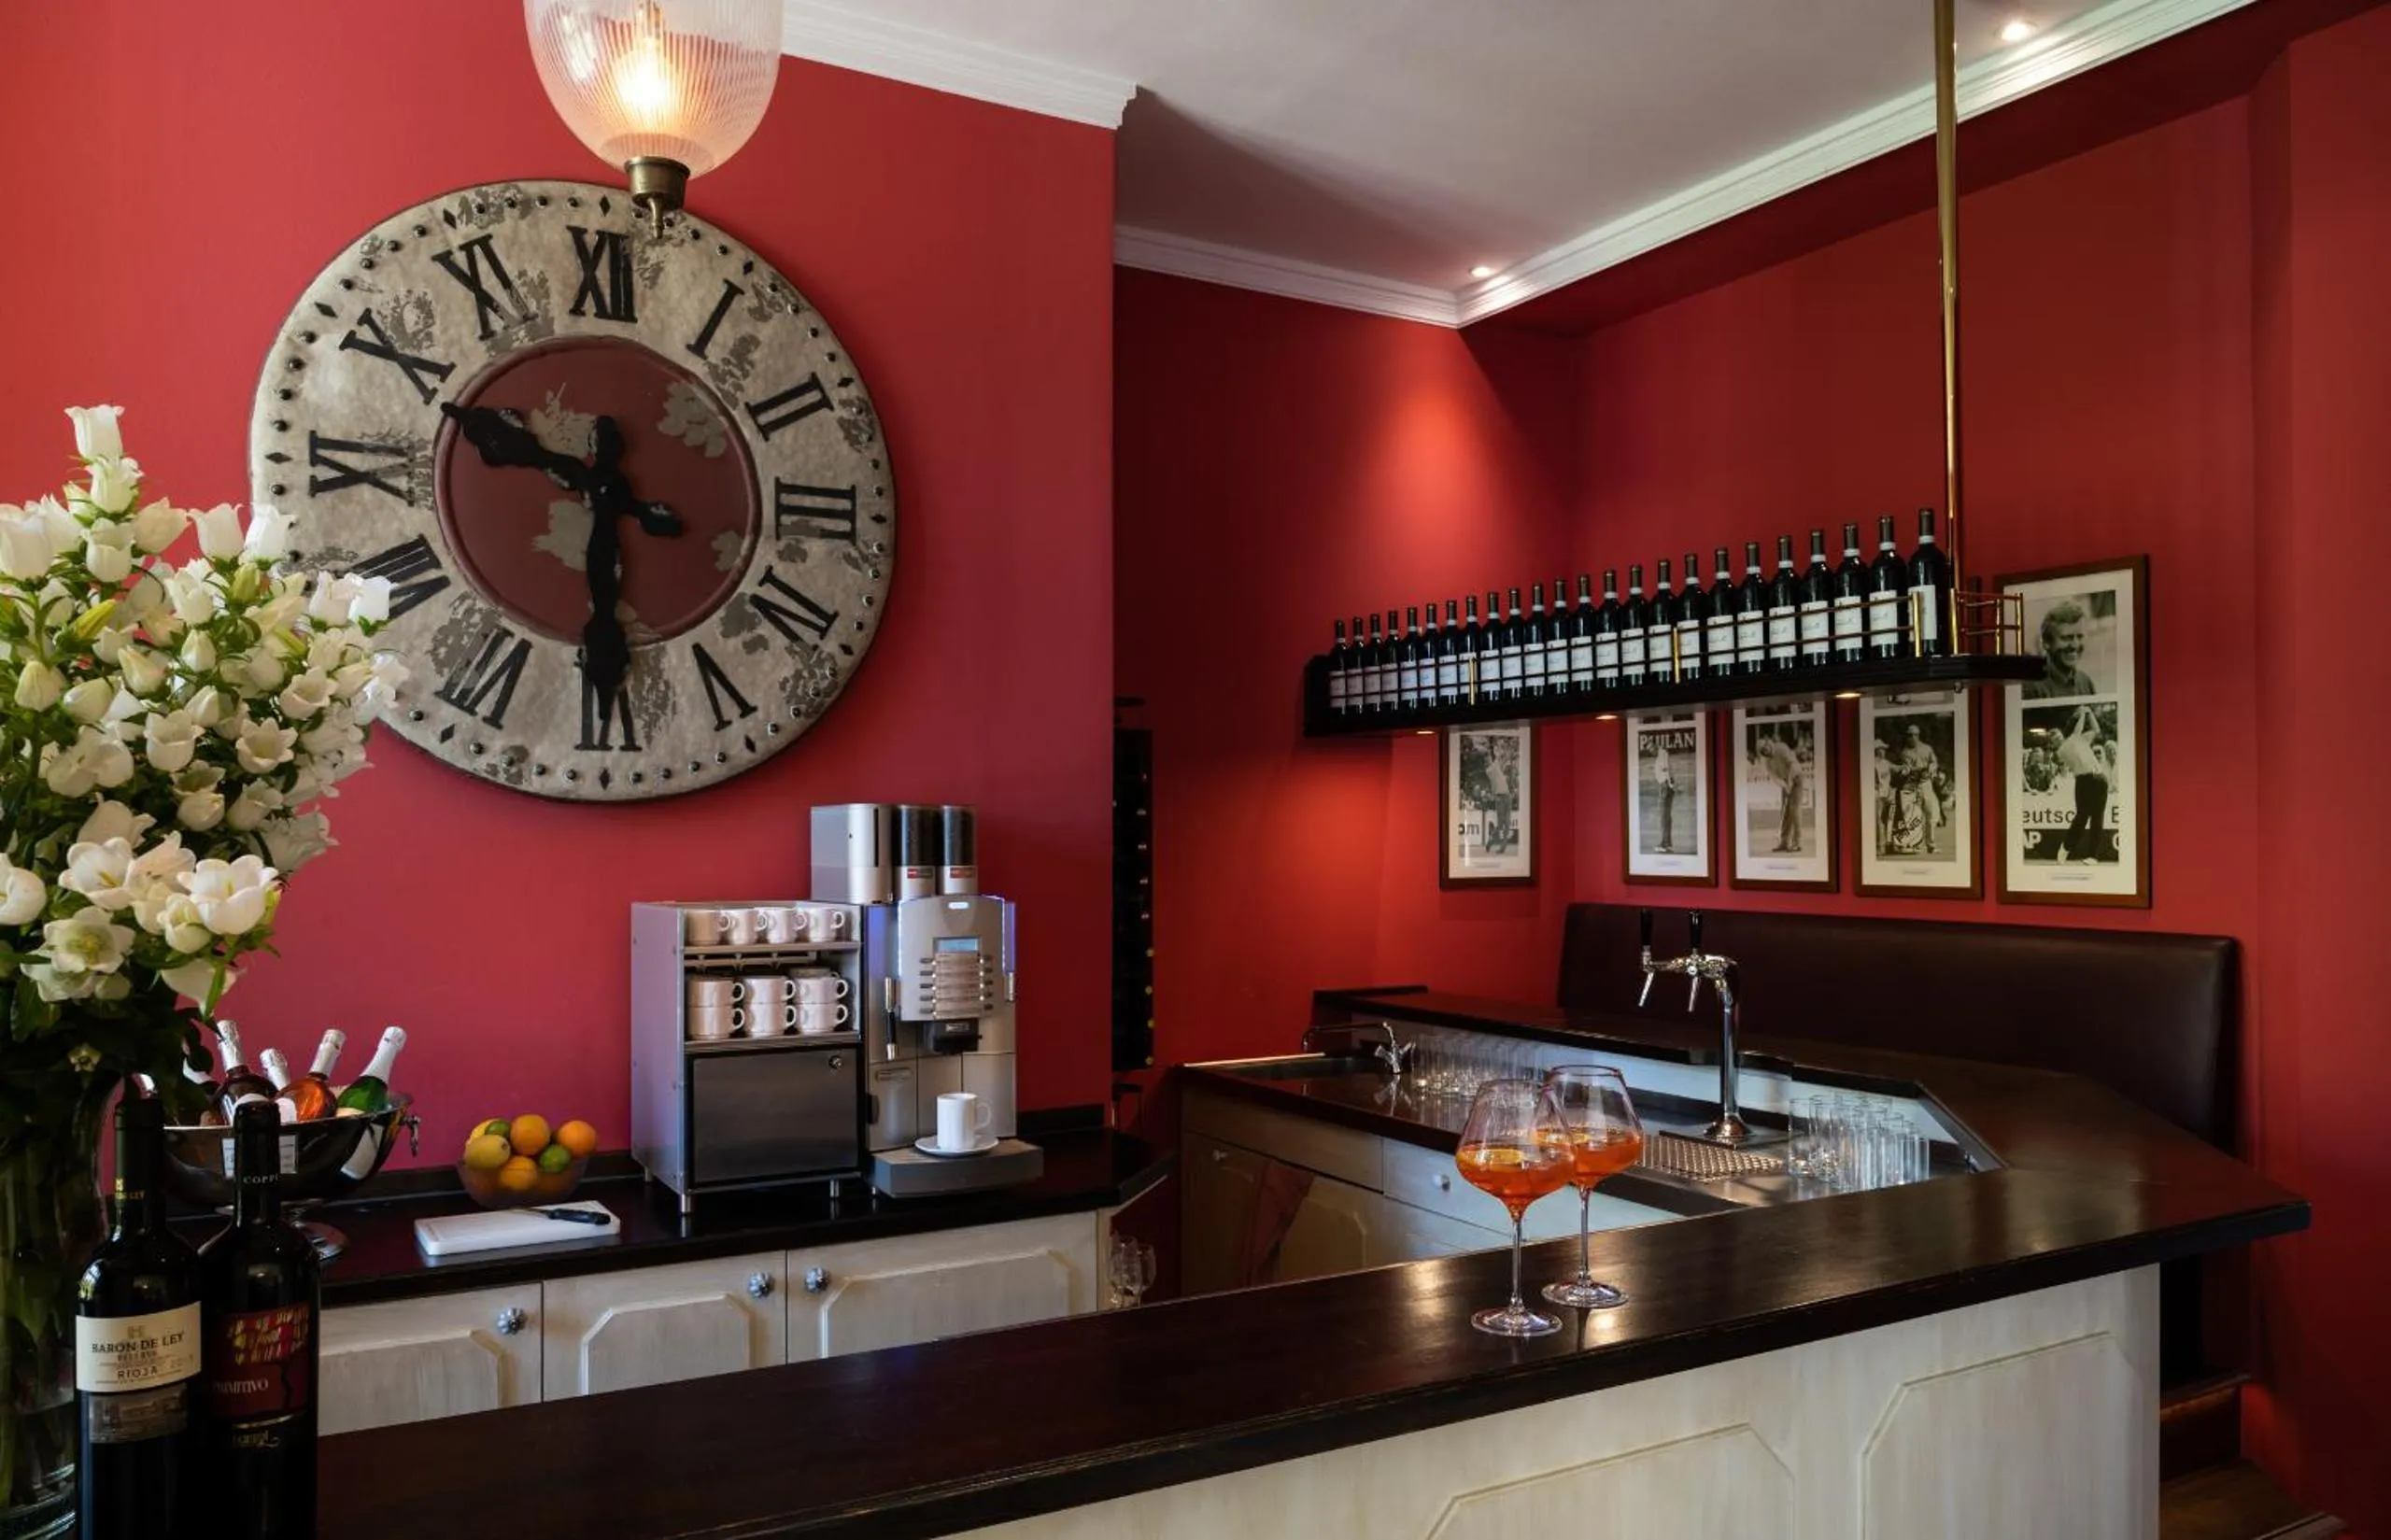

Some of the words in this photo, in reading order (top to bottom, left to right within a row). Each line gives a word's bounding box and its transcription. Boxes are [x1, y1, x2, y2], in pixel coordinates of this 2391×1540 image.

[432, 234, 538, 341] XI
[566, 226, 637, 322] XII
[339, 307, 457, 405] X
[686, 279, 744, 360] I
[745, 372, 833, 442] II
[774, 476, 856, 545] III
[749, 565, 839, 652] IV
[692, 643, 757, 731] V
[92, 1340, 136, 1353] BARON
[141, 1337, 159, 1350] DE
[163, 1330, 185, 1346] LEY
[118, 1366, 158, 1379] RIOJA
